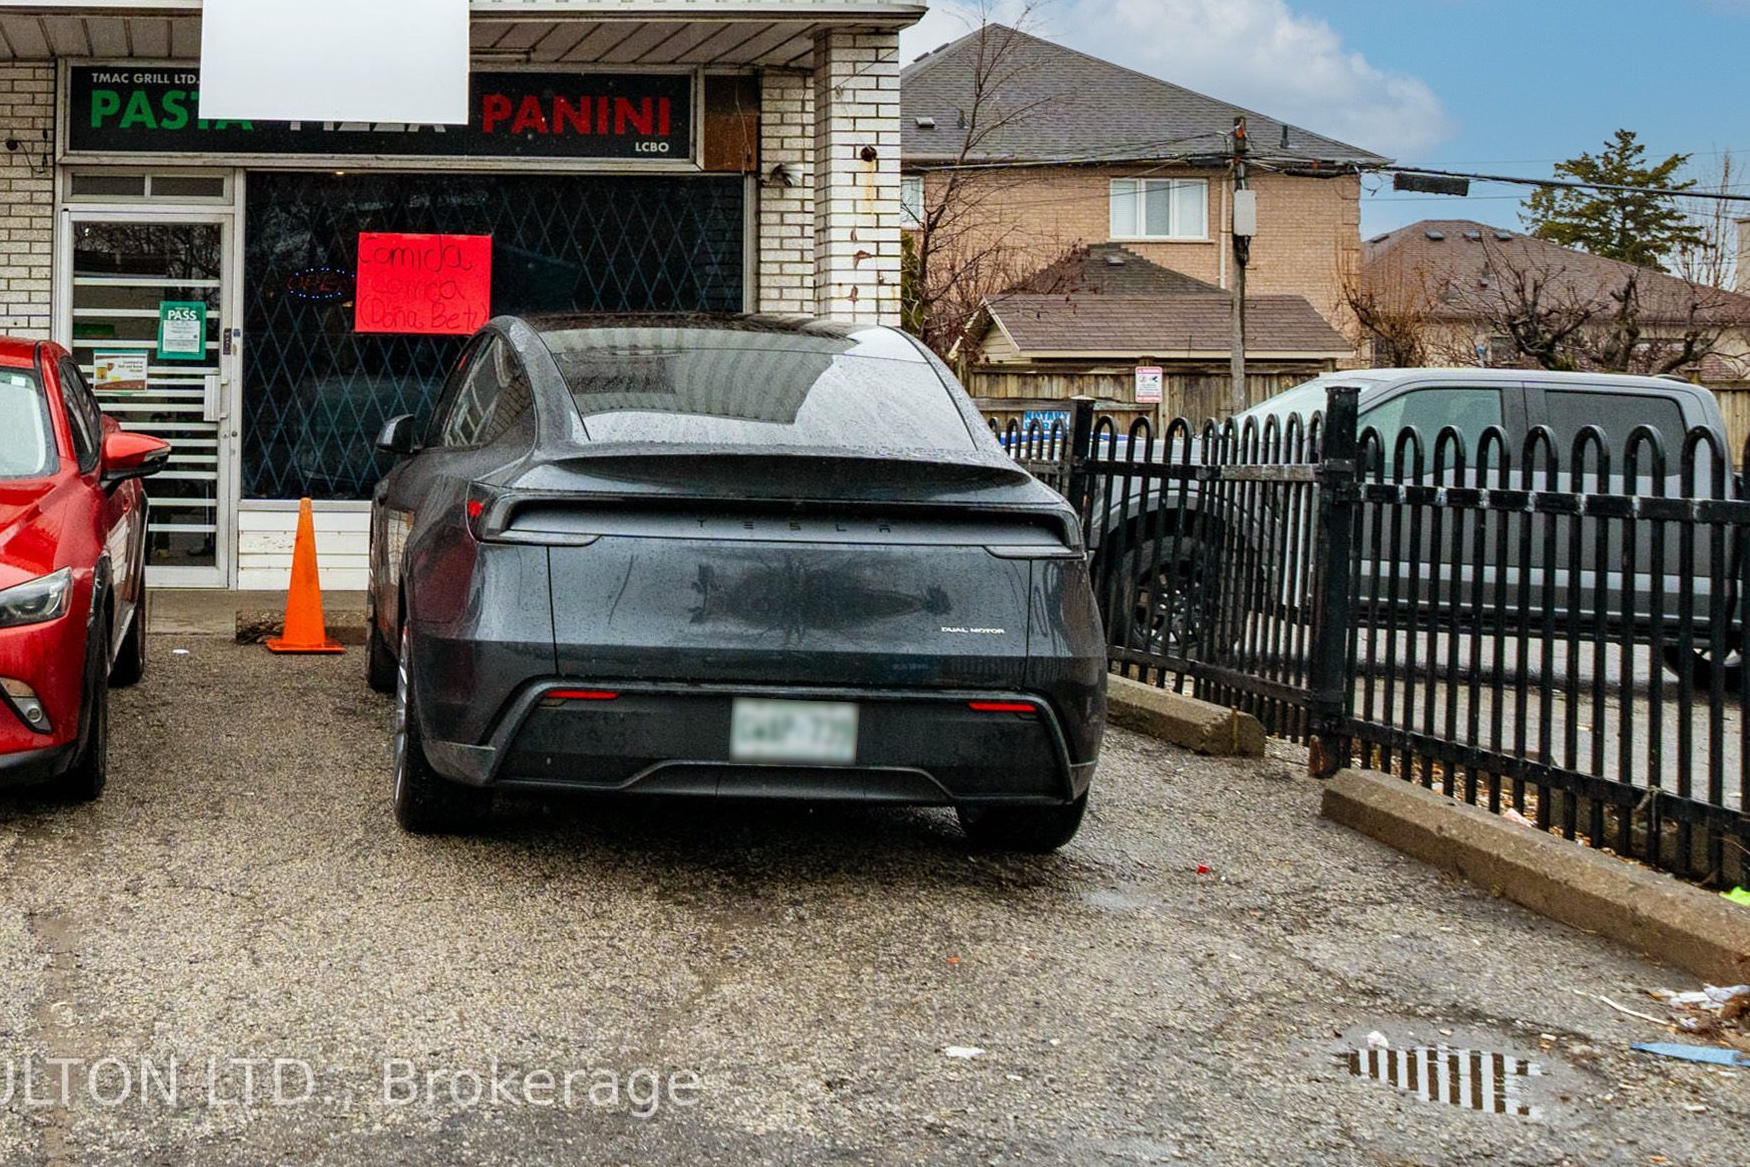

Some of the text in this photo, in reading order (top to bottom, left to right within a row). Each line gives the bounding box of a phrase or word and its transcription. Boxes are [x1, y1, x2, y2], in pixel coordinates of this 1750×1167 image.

[91, 72, 200, 84] TMAC GRILL LTD.
[482, 94, 671, 136] PANINI
[635, 141, 670, 153] LCBO
[167, 310, 198, 320] PASS
